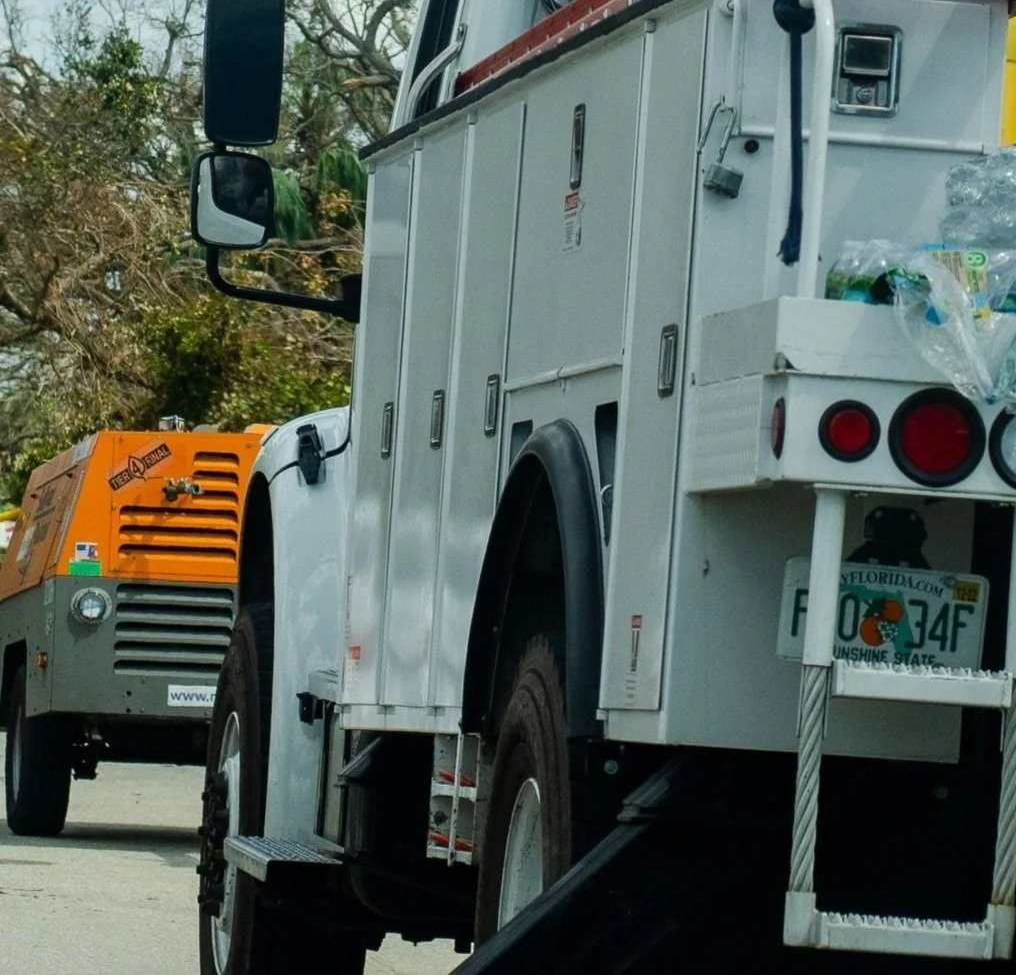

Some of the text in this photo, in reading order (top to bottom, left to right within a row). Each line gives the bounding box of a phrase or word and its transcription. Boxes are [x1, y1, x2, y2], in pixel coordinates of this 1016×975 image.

[111, 471, 131, 489] TIER
[144, 446, 169, 467] FINAL
[841, 571, 944, 597] YFLORIDA.COM
[833, 646, 888, 662] UNSHINE
